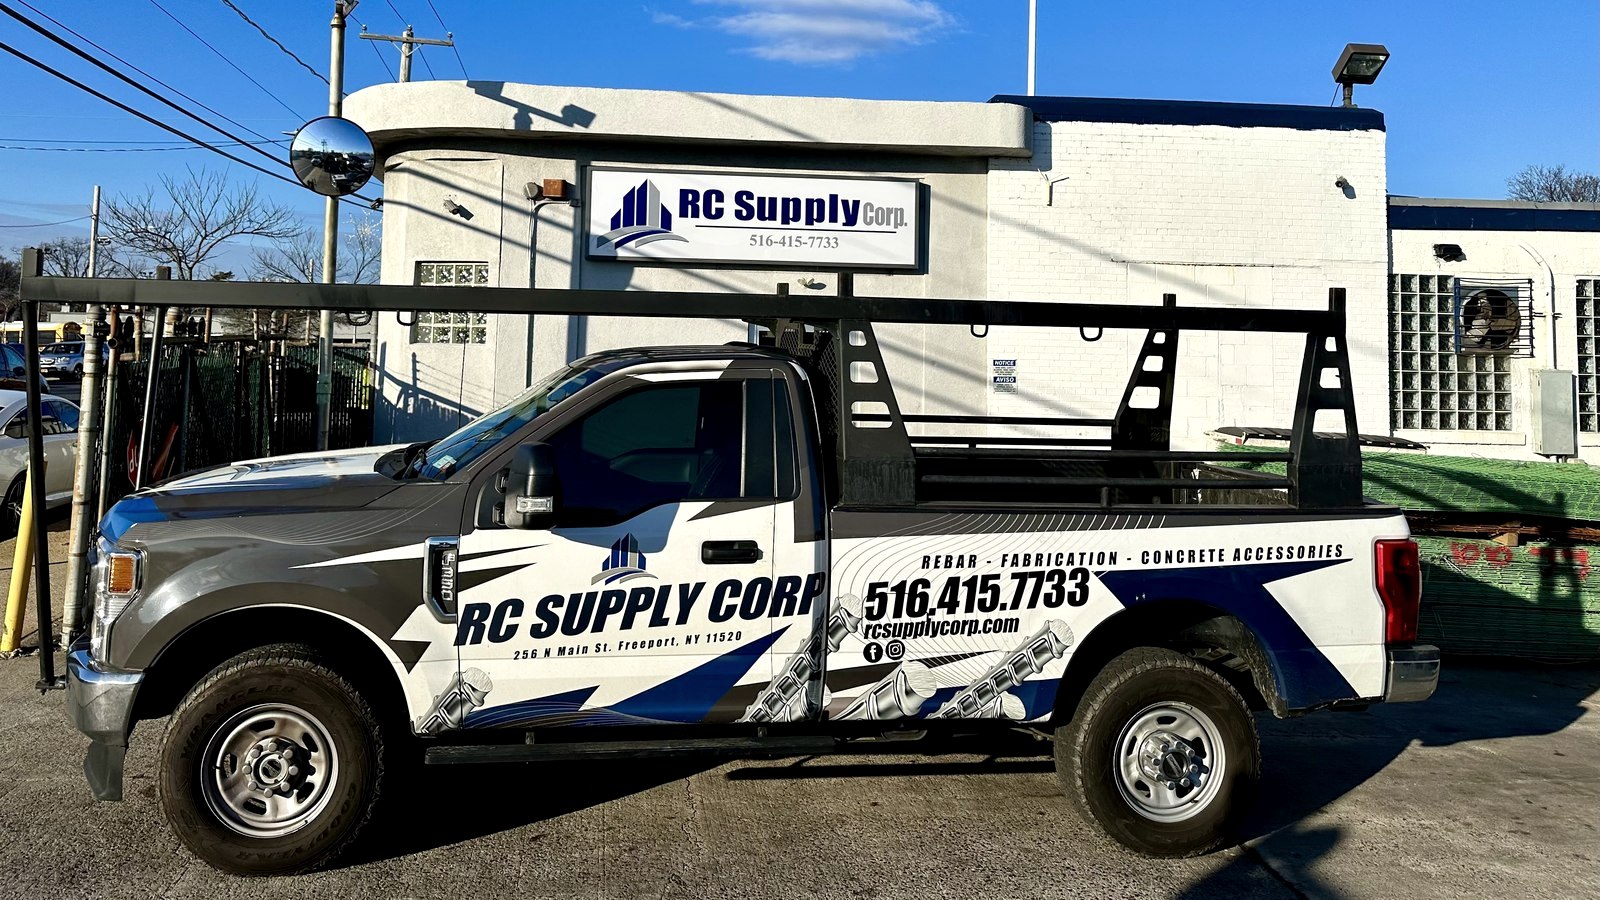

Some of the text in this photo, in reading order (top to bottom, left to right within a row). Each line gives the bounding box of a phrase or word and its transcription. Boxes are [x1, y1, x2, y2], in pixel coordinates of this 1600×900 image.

[679, 188, 908, 229] RC Supply Corp.
[749, 234, 839, 249] 516-415-7733
[921, 553, 978, 570] REBAR
[1000, 550, 1118, 568] FABRICATION
[1141, 547, 1226, 565] CONCRETE
[1233, 544, 1344, 562] ACCESSORIES
[453, 571, 826, 647] RC SUPPLY CORP
[864, 567, 1089, 621] 516.415.7733
[864, 616, 1019, 640] rcsupplycorp.com
[513, 630, 743, 661] 256 N Main St. Freeport, NY 11520
